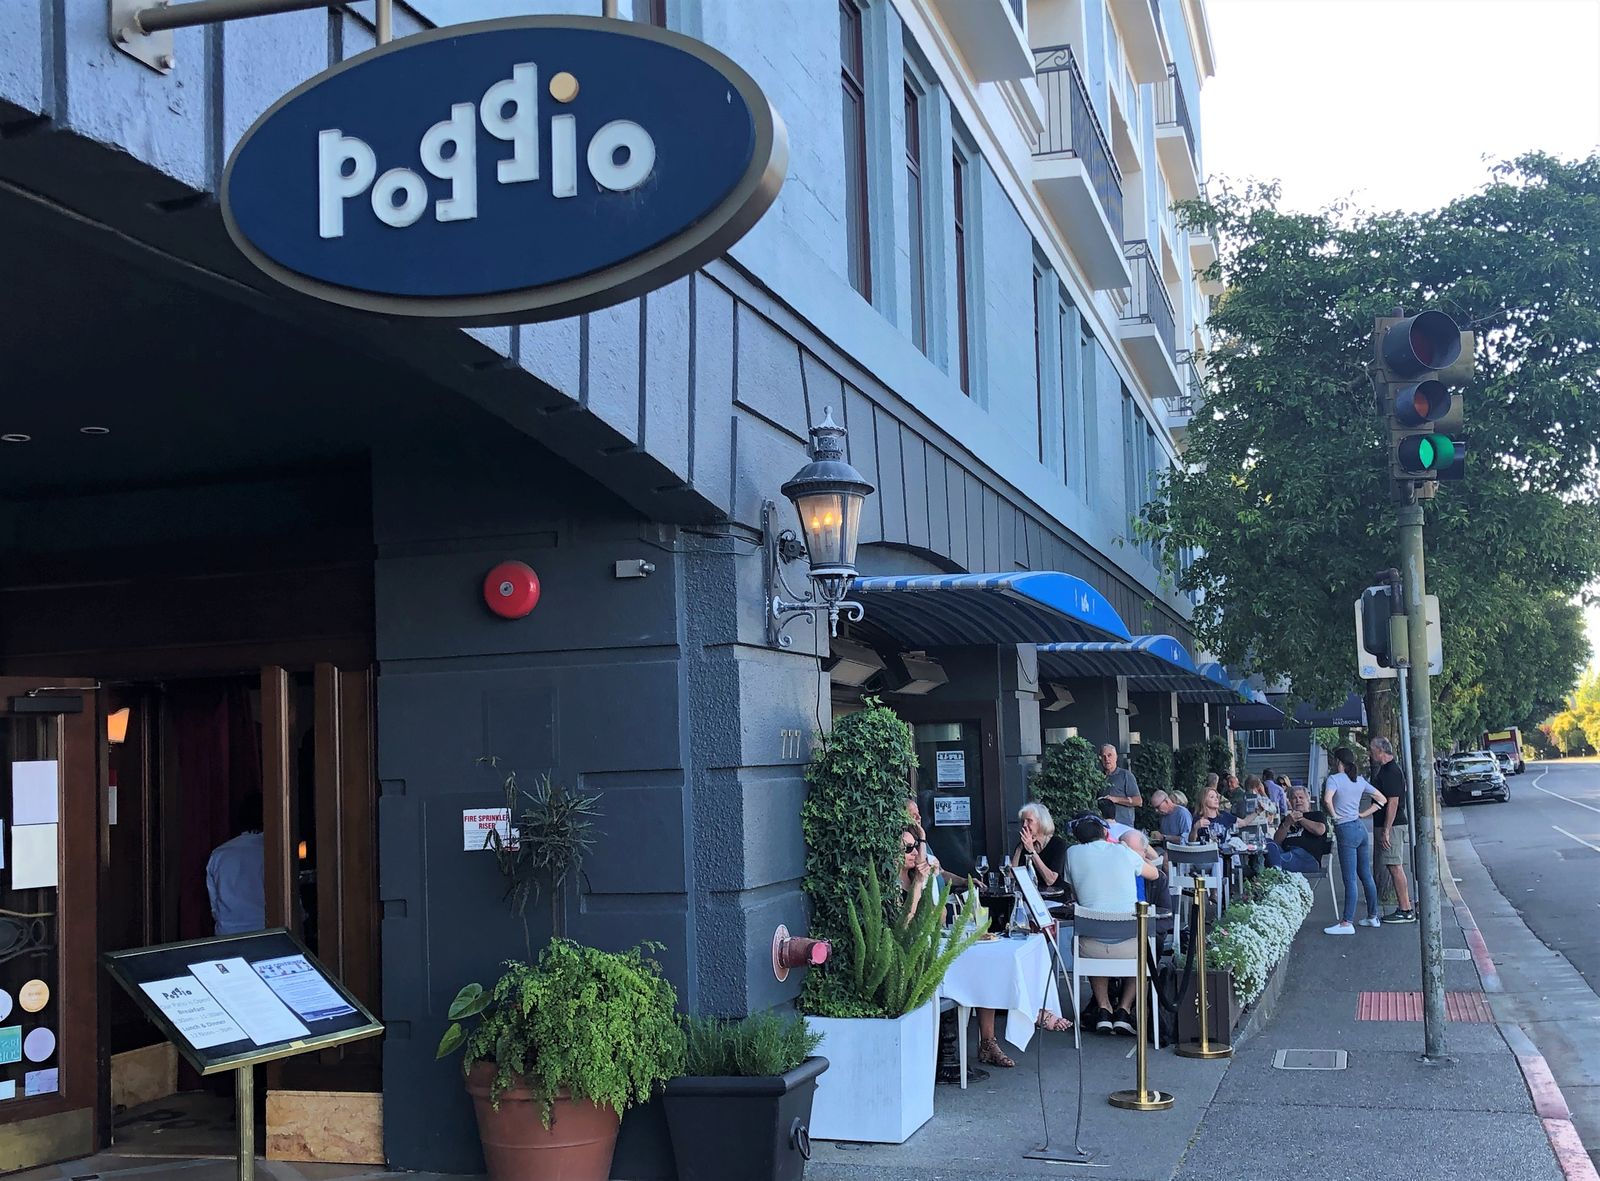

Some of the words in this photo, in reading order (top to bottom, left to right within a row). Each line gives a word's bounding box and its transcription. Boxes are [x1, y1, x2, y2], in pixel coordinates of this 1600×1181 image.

[177, 1006, 207, 1015] Breakfast
[181, 1024, 200, 1032] Lunch
[207, 1020, 226, 1028] Dinner
